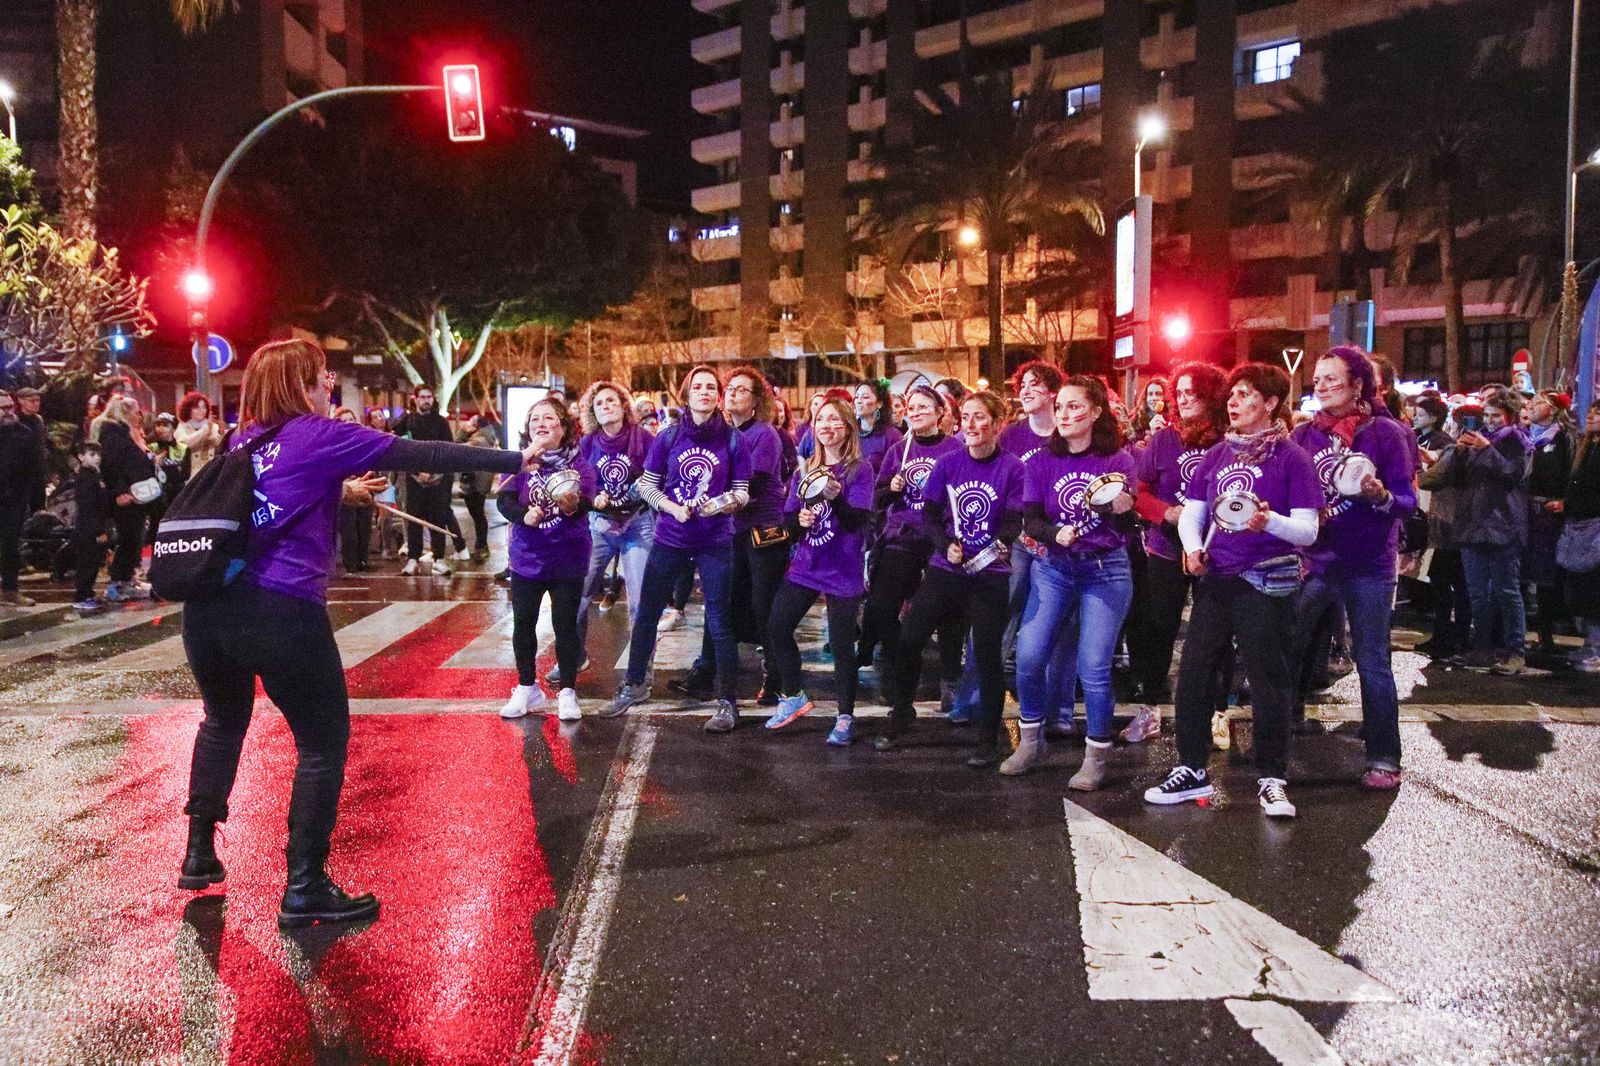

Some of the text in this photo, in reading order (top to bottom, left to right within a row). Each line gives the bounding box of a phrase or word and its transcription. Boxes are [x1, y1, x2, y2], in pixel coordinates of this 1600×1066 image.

[677, 447, 720, 466] JUNTAS SOMOS
[1216, 462, 1244, 480] JUNTAS
[955, 481, 998, 501] JUNTAS SOMOS
[1053, 472, 1096, 492] JUNTAS SOM
[154, 537, 212, 557] Reebok
